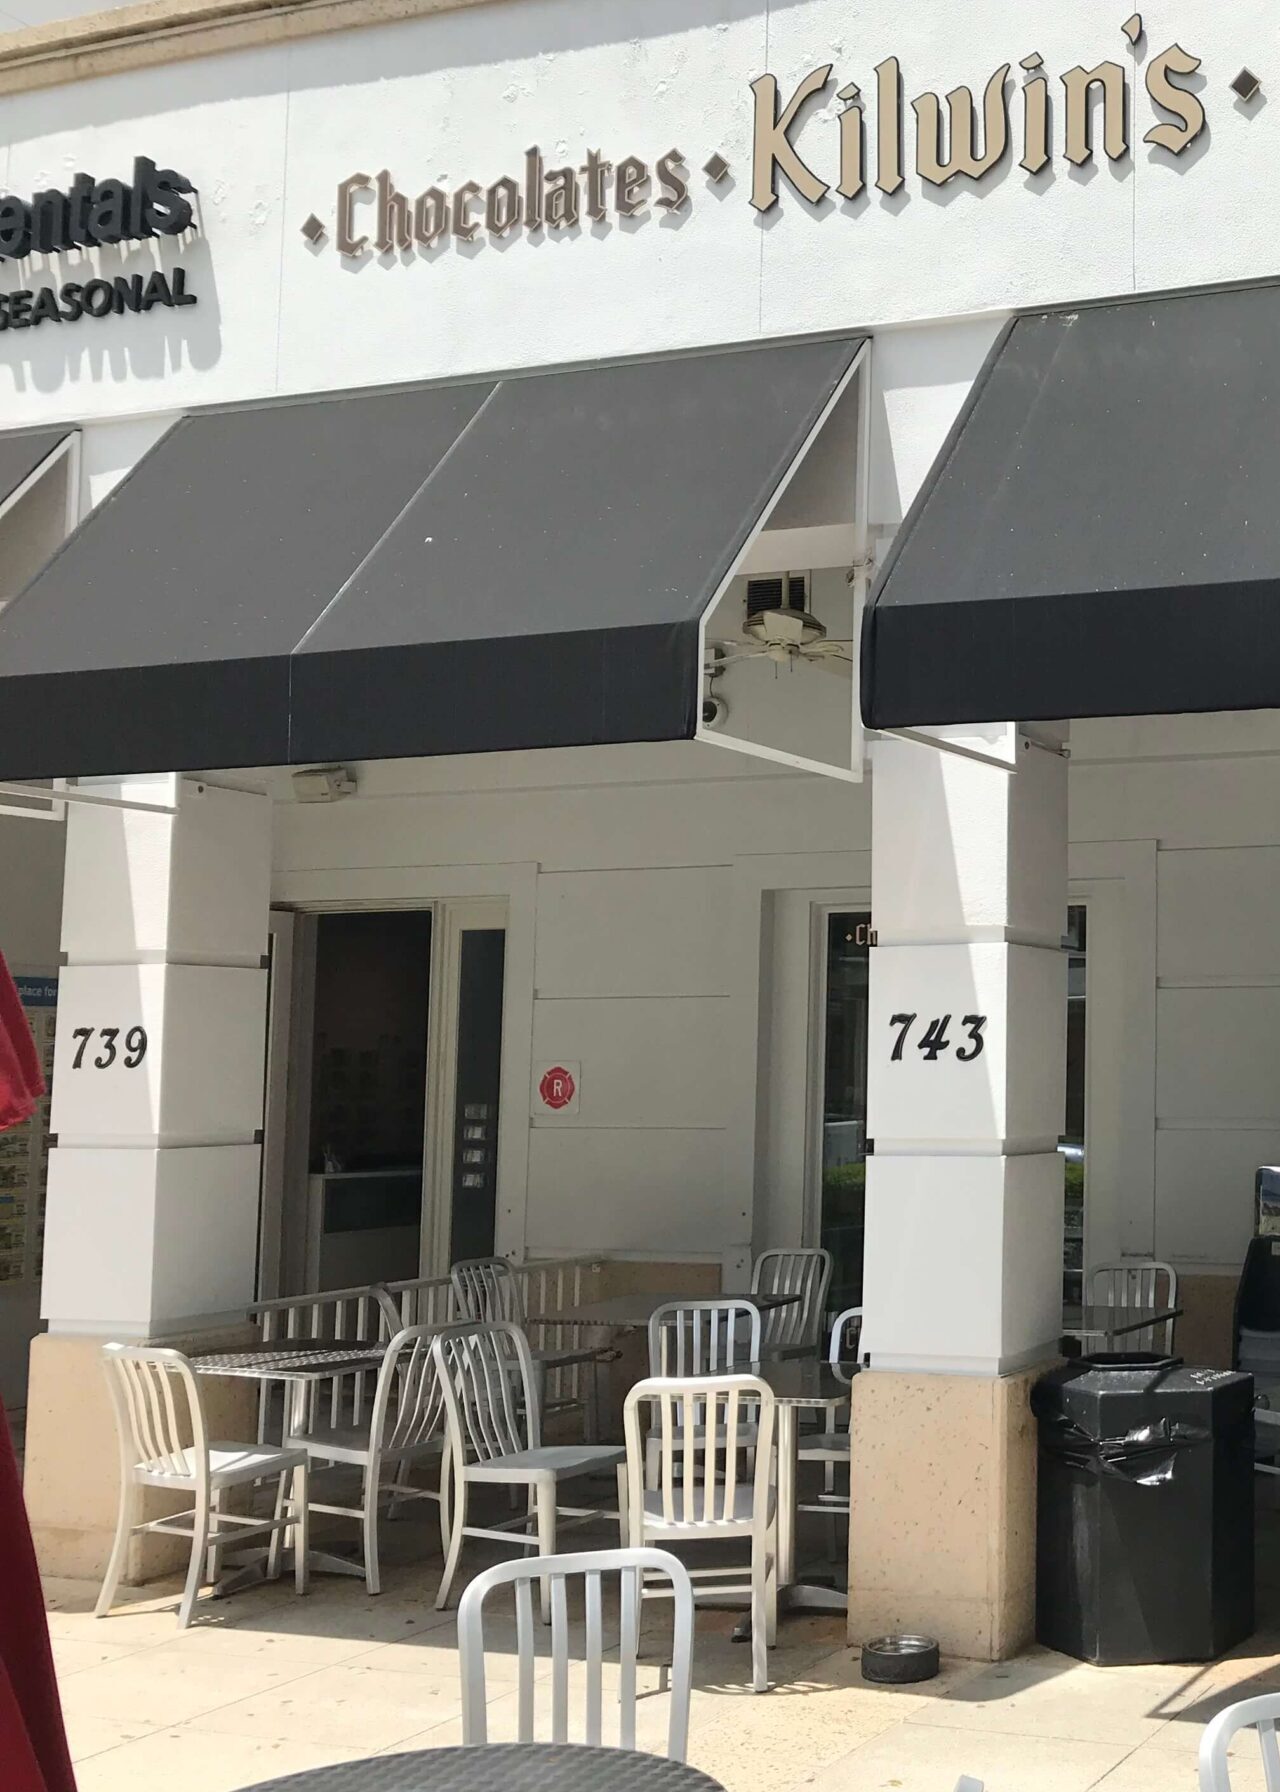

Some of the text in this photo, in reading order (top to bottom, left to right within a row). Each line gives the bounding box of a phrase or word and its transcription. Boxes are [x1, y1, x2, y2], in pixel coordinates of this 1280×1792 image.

[335, 145, 688, 257] Chocolates
[748, 13, 1206, 213] Kilwin's
[71, 1025, 148, 1069] 739
[889, 1013, 987, 1062] 743
[553, 1079, 563, 1097] R
